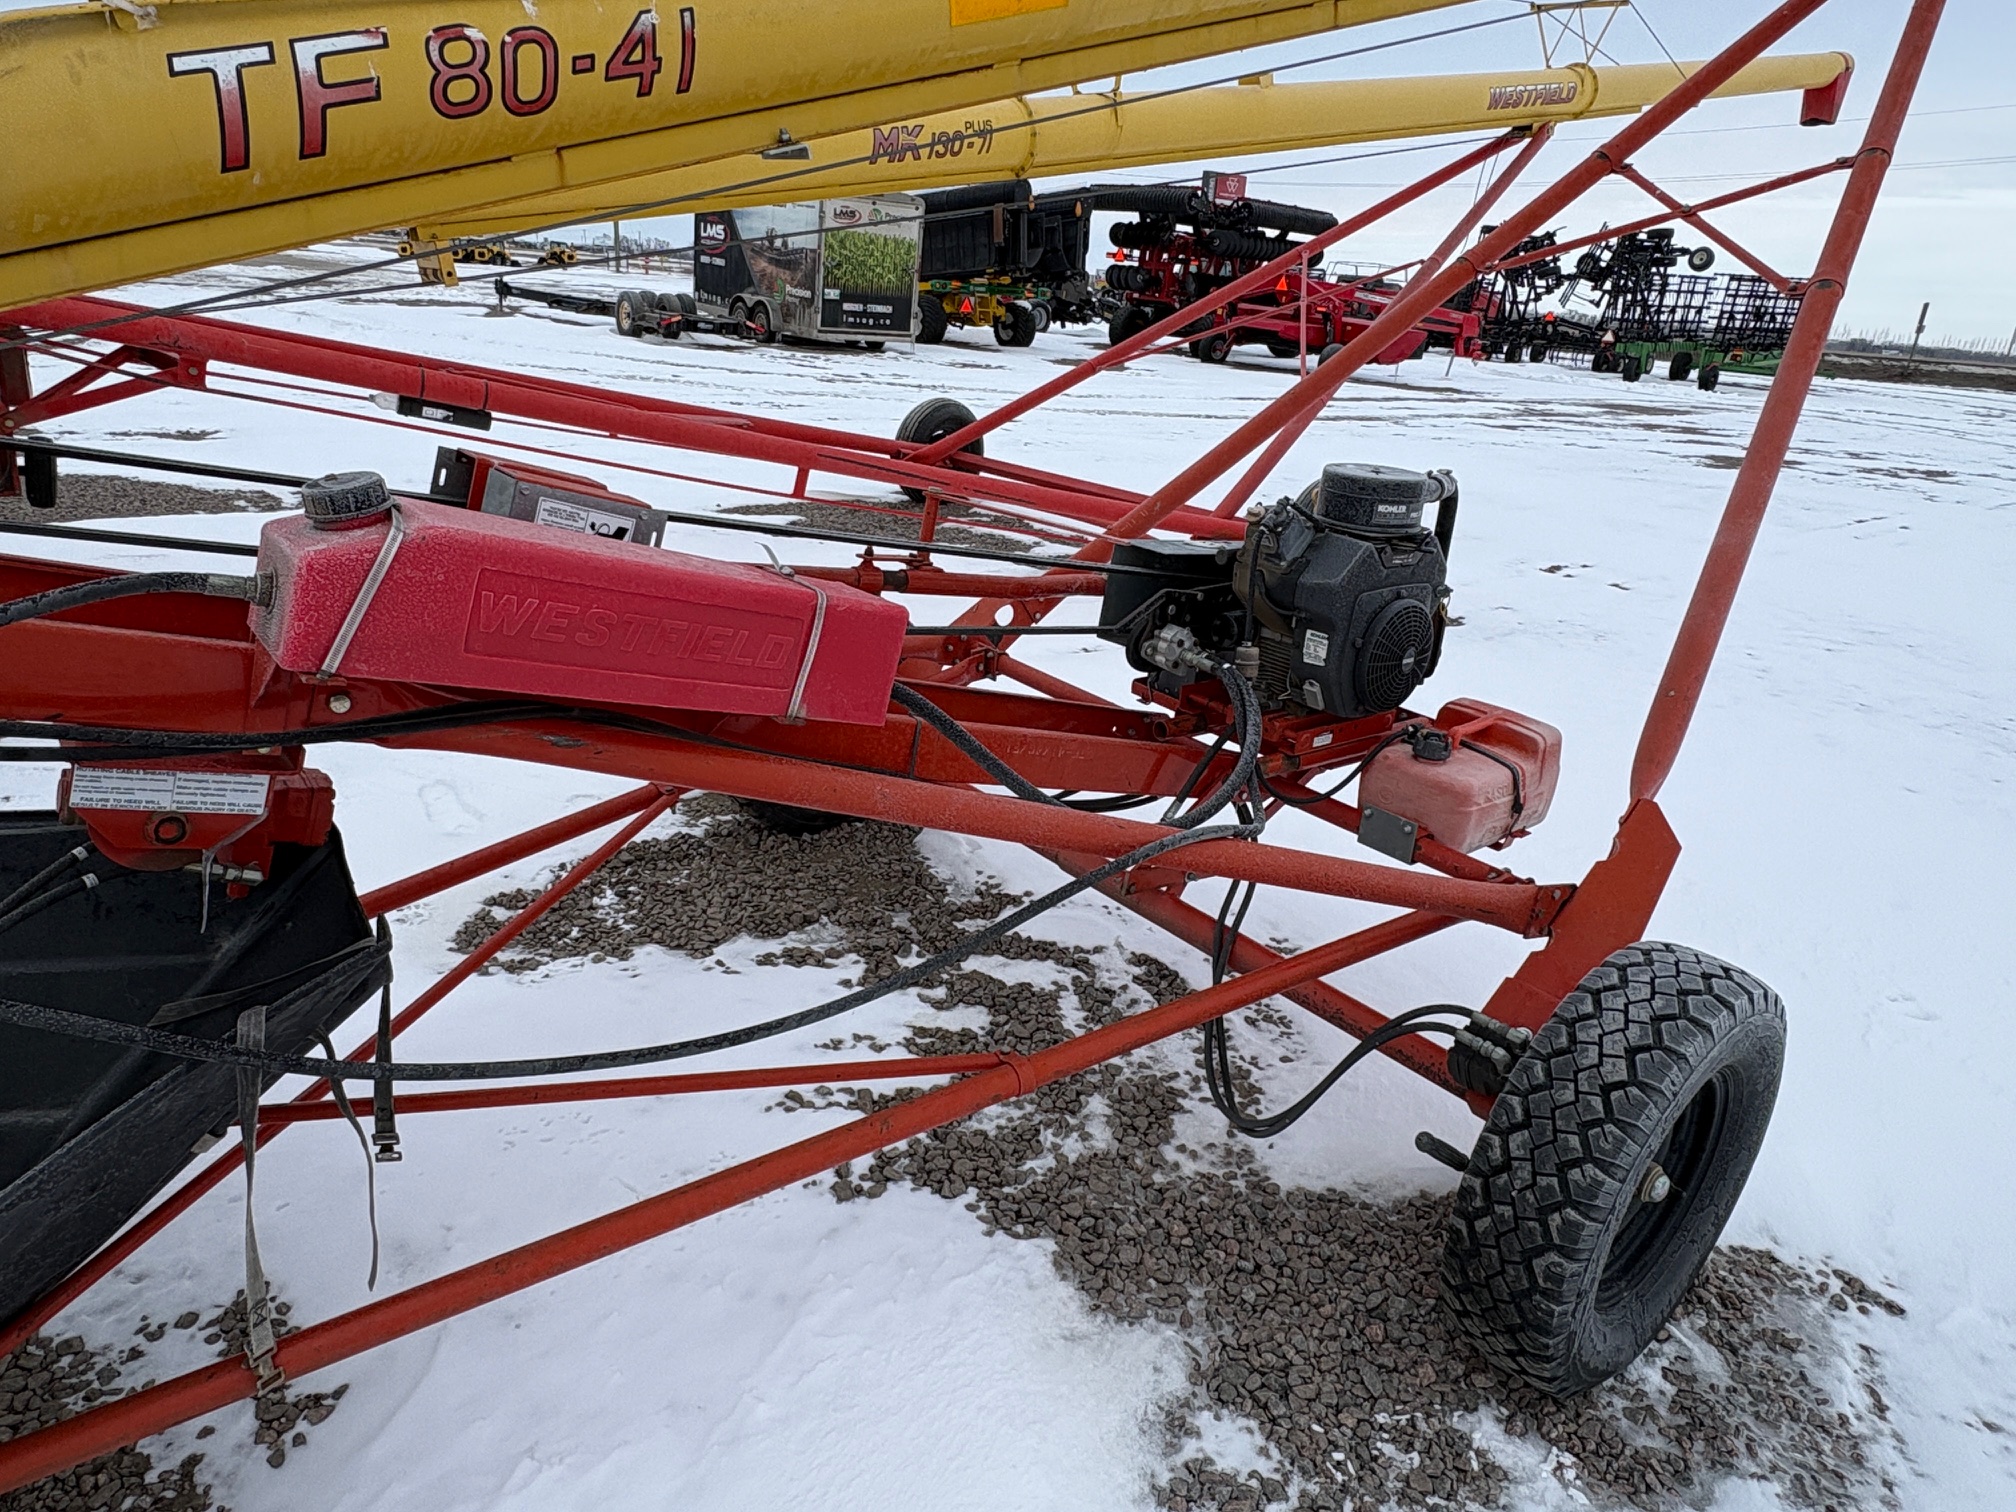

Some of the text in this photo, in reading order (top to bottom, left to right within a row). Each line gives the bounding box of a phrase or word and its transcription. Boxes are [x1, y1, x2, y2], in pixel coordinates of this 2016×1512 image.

[167, 7, 697, 174] TF 80-41
[1486, 82, 1577, 110] WESTFIELD
[964, 120, 993, 133] PLUS
[868, 125, 924, 165] MK
[833, 207, 856, 218] LMS
[700, 222, 726, 240] LMS
[1377, 504, 1407, 513] KOHLER
[478, 590, 796, 671] WESTFIELD
